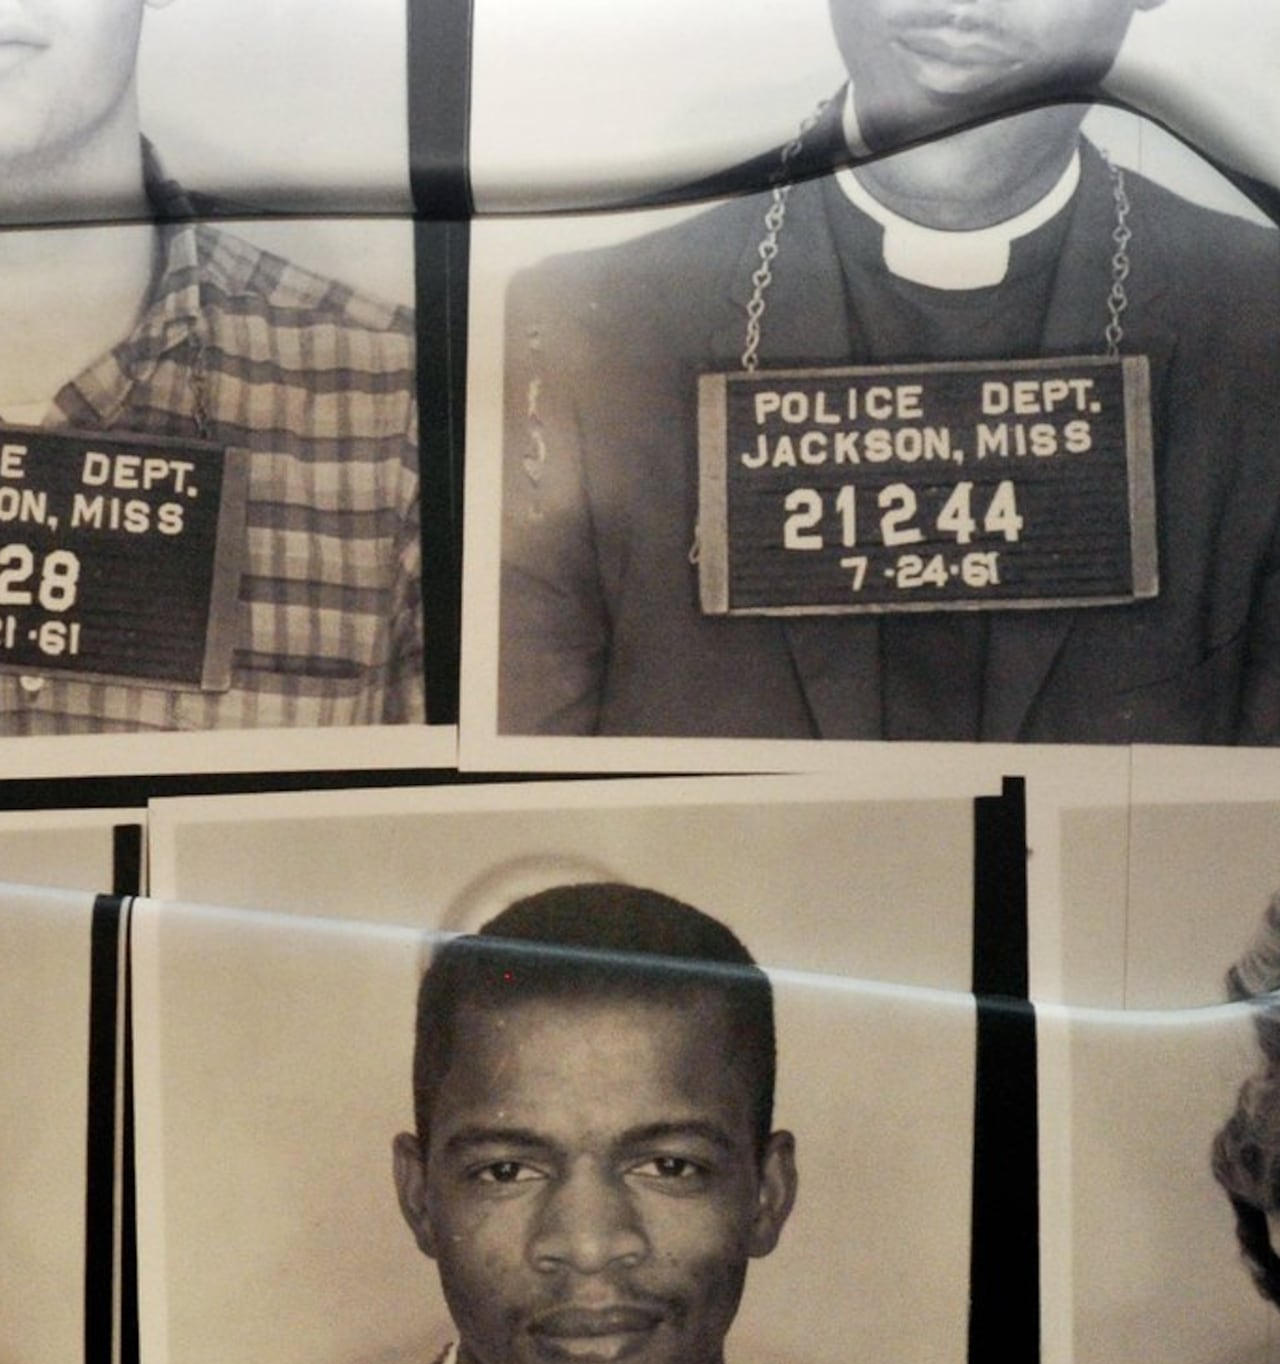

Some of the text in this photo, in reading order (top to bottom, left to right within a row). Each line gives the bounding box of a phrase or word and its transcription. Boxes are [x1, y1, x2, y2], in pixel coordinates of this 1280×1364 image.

[754, 378, 1102, 425] POLICE DEPT.
[741, 419, 1093, 469] JACKSON, MISS
[81, 451, 199, 497] DEPT.
[70, 494, 186, 536] MISS
[783, 479, 1024, 551] 21244
